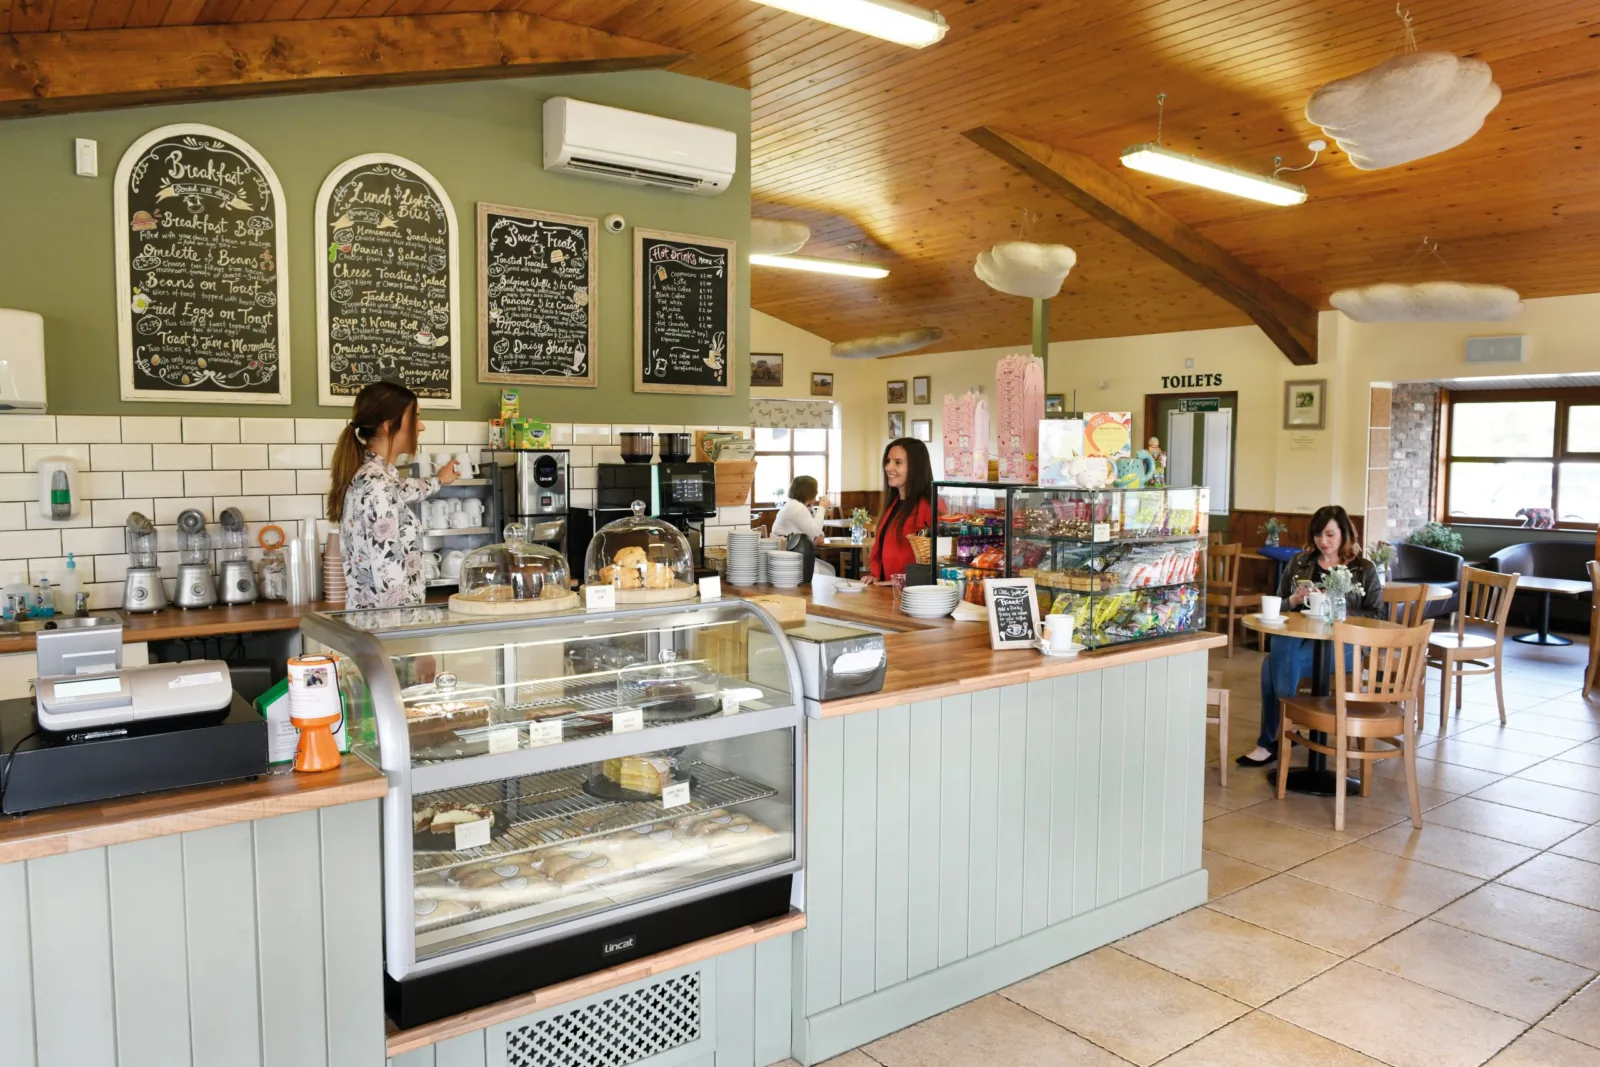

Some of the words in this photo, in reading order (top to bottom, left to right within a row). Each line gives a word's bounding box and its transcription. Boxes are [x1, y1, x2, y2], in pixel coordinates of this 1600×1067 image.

[165, 150, 245, 186] Breakfast
[349, 181, 392, 206] Lunch
[400, 188, 432, 210] Light
[397, 205, 431, 224] Bites
[162, 211, 229, 234] Breakfast
[234, 221, 264, 242] Bap
[140, 231, 159, 242] Filled
[162, 232, 176, 240] with
[212, 234, 219, 243] of
[221, 235, 238, 245] bacon
[357, 225, 403, 239] Homemade
[406, 228, 446, 246] Sandwich
[504, 225, 541, 247] Sweet
[543, 230, 579, 256] Treats
[143, 244, 201, 262] Omelette
[217, 249, 258, 268] Beans
[351, 243, 384, 258] Panini
[398, 247, 428, 262] Salad
[493, 253, 522, 265] Toasted
[652, 247, 670, 260] Hot
[228, 263, 242, 272] from
[333, 263, 372, 278] Cheese
[376, 267, 413, 282] Toastie
[421, 274, 447, 288] Salad
[145, 271, 195, 289] Beans
[200, 281, 217, 291] on
[221, 278, 262, 295] Toast
[499, 275, 530, 289] Belgian
[172, 288, 179, 297] of
[179, 289, 196, 298] toast
[201, 292, 224, 302] topped
[360, 290, 396, 306] Jacket
[427, 301, 450, 316] Salad
[501, 295, 536, 307] Pancake
[545, 299, 555, 309] Ice
[556, 301, 580, 311] Cream
[163, 319, 177, 327] Two
[182, 302, 214, 324] Eggs
[220, 310, 236, 321] on
[237, 307, 274, 329] Toast
[332, 316, 359, 331] Soup
[369, 317, 398, 331] Warm
[400, 318, 419, 331] Roll
[157, 330, 192, 346] Toast
[200, 335, 222, 350] Jam
[146, 344, 162, 352] Two
[162, 344, 183, 353] slices
[184, 346, 192, 355] of
[194, 349, 213, 357] toast
[215, 350, 231, 358] with
[378, 343, 407, 356] Salad
[513, 339, 544, 358] Daisy
[545, 340, 575, 355] Shake
[350, 362, 375, 374] KIDS
[399, 366, 433, 382] Sausage
[432, 369, 450, 381] Roll
[1161, 373, 1222, 389] TOILETS
[332, 385, 350, 394] Please
[1188, 399, 1218, 408] Emergency
[604, 937, 634, 953] Lincat
